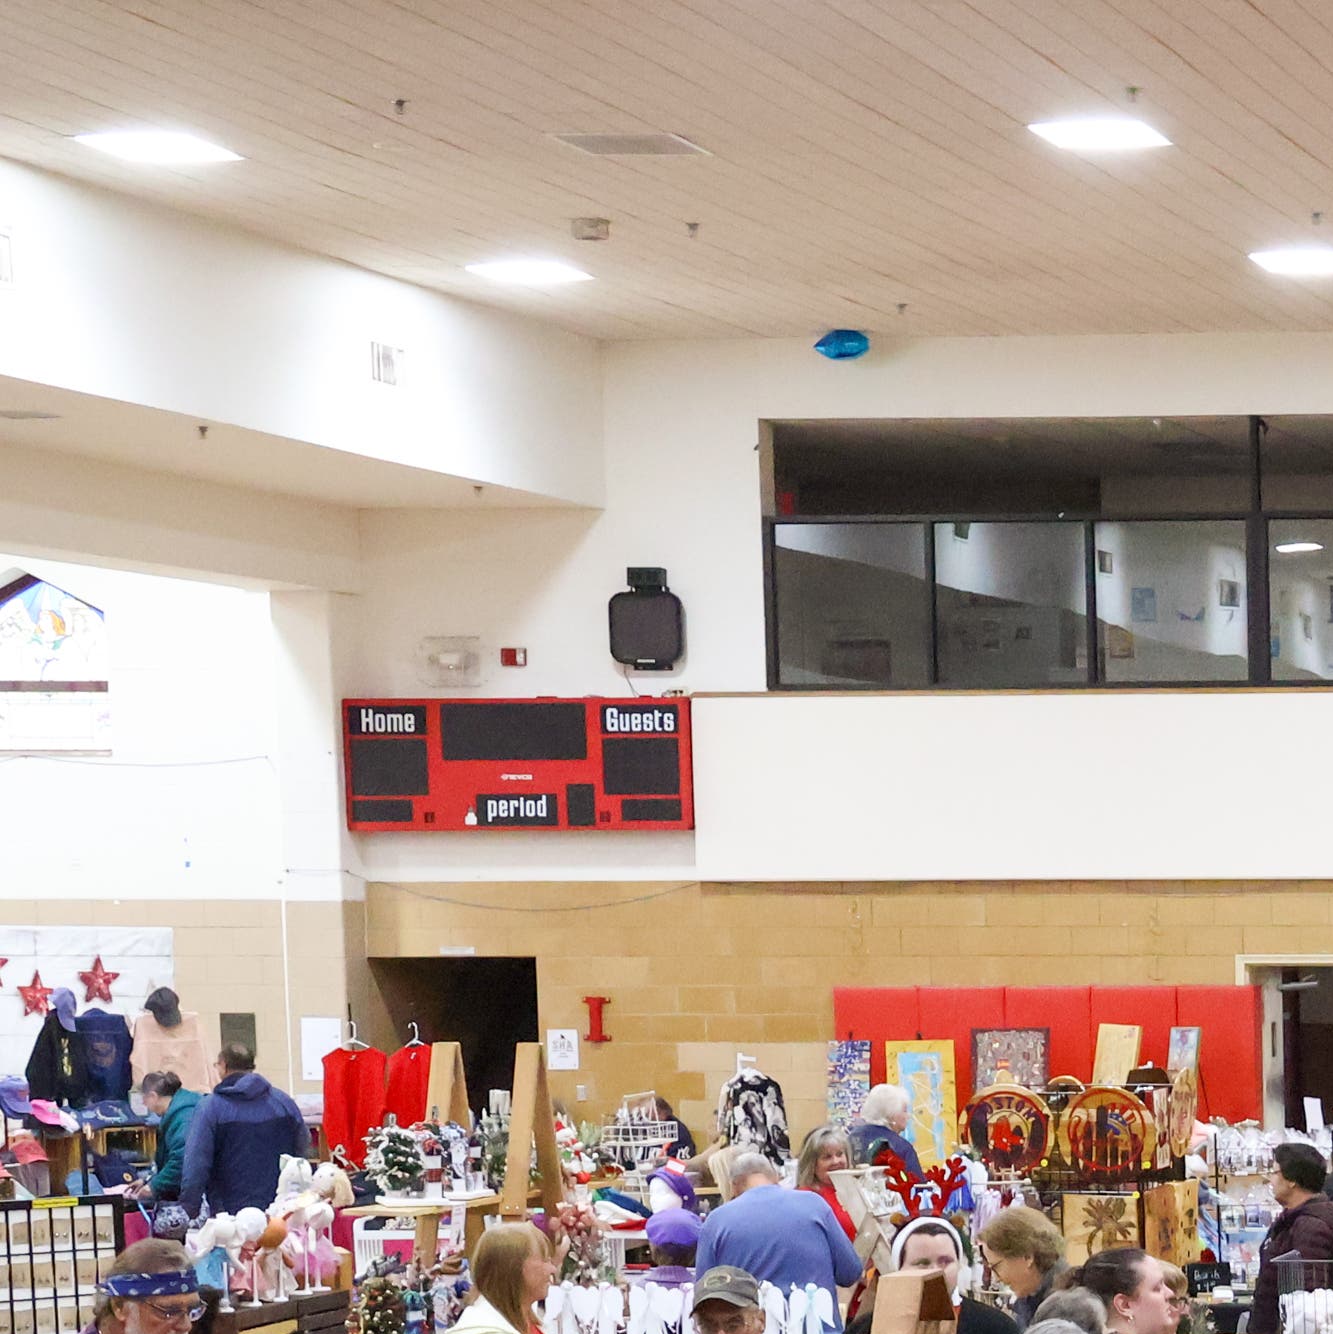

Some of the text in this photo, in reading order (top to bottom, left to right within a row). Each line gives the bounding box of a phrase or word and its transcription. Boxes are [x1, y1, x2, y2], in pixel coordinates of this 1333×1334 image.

[361, 707, 675, 733] Home Guests
[487, 795, 547, 822] period
